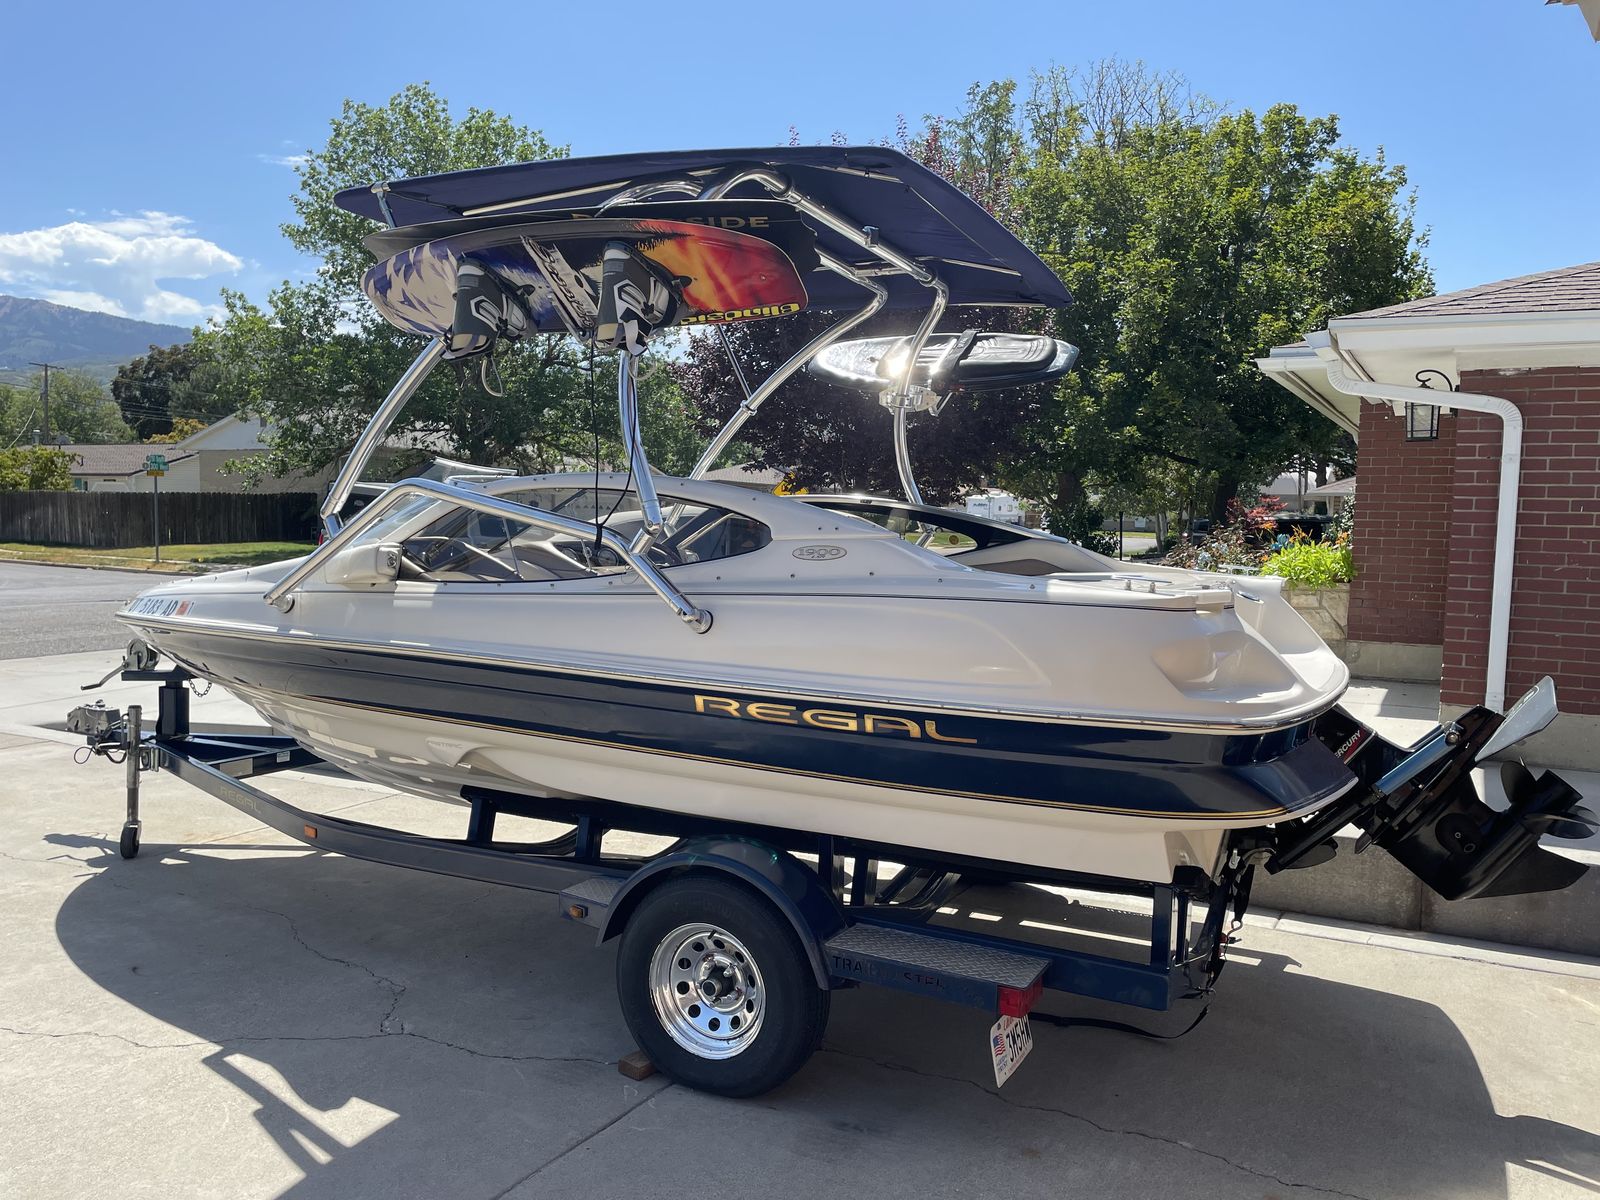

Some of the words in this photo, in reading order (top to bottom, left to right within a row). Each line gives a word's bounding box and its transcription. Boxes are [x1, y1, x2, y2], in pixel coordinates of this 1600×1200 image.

[680, 303, 801, 325] Blindsid
[693, 694, 978, 744] REGAL
[1333, 730, 1362, 758] ERCURY
[220, 786, 263, 816] REGAL
